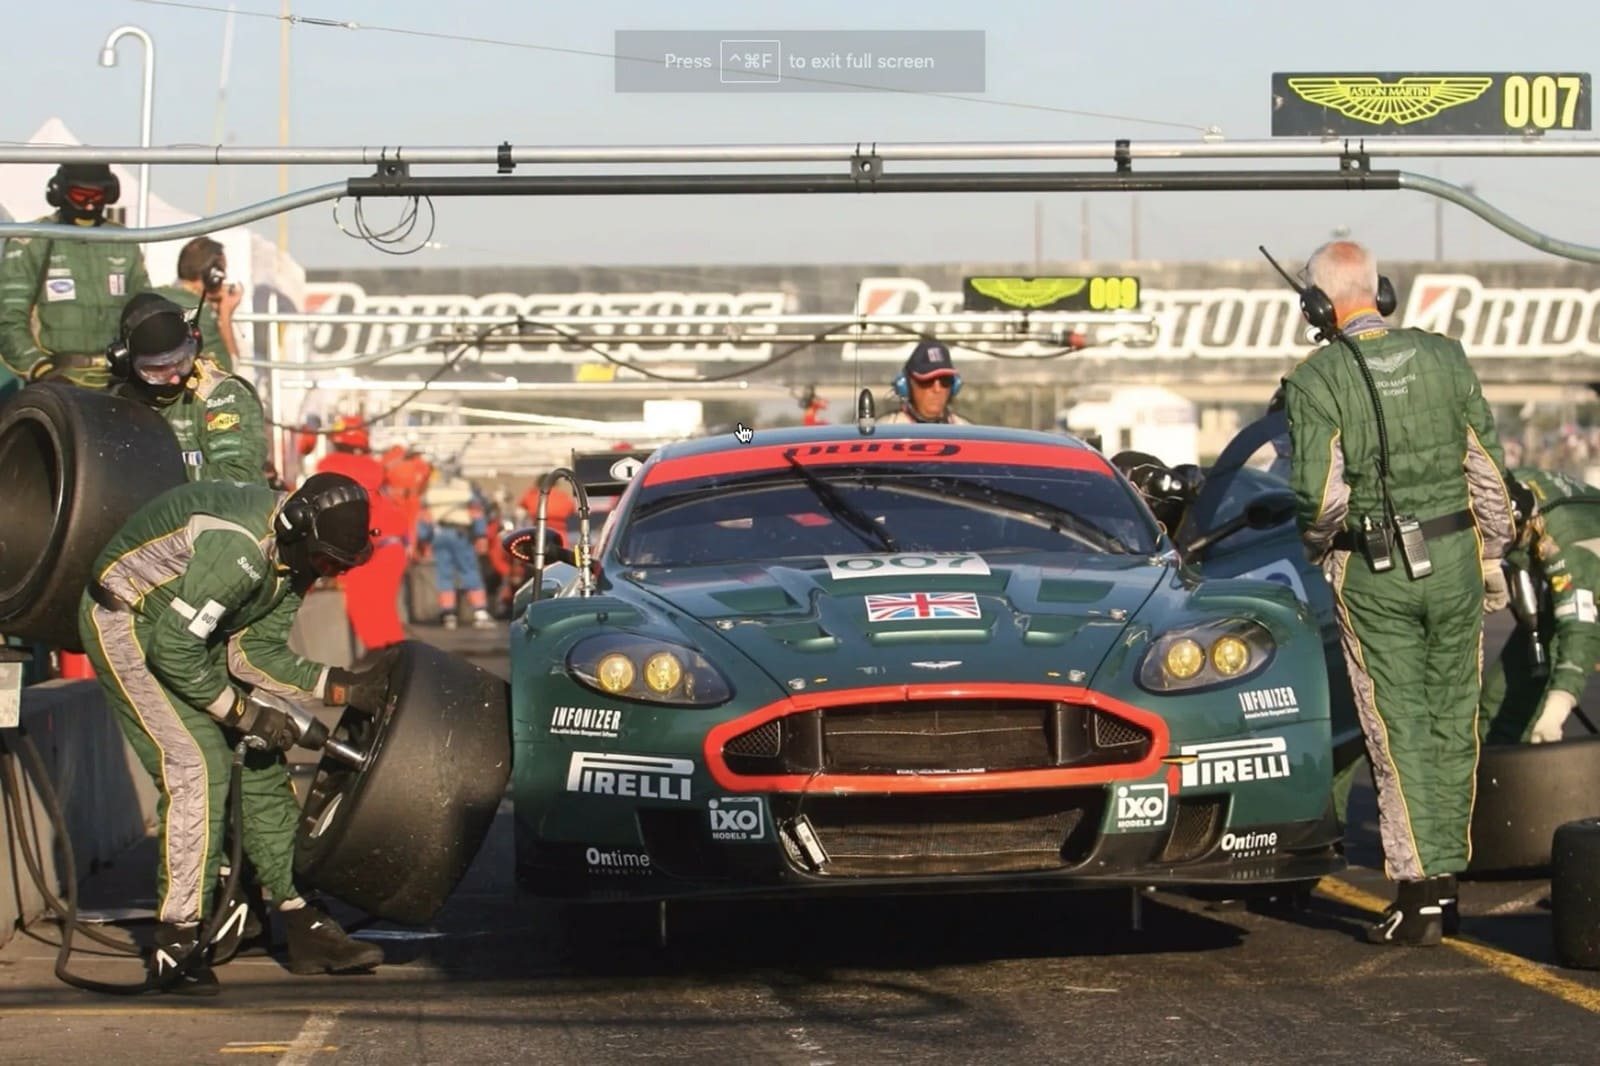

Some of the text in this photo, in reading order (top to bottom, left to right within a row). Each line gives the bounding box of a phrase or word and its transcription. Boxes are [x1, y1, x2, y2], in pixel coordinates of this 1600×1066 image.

[1351, 86, 1431, 97] ASTON MARTIN
[1504, 75, 1581, 128] 007
[836, 555, 977, 571] 007
[1238, 686, 1297, 712] INFONIZER
[551, 706, 622, 730] INFONIZER
[1181, 736, 1290, 787] PIRELLI
[566, 751, 695, 800] PIRELLI
[1117, 819, 1151, 828] MODELS
[712, 832, 747, 840] MODELS
[1221, 831, 1278, 850] Ontime
[586, 847, 650, 867] Ontime
